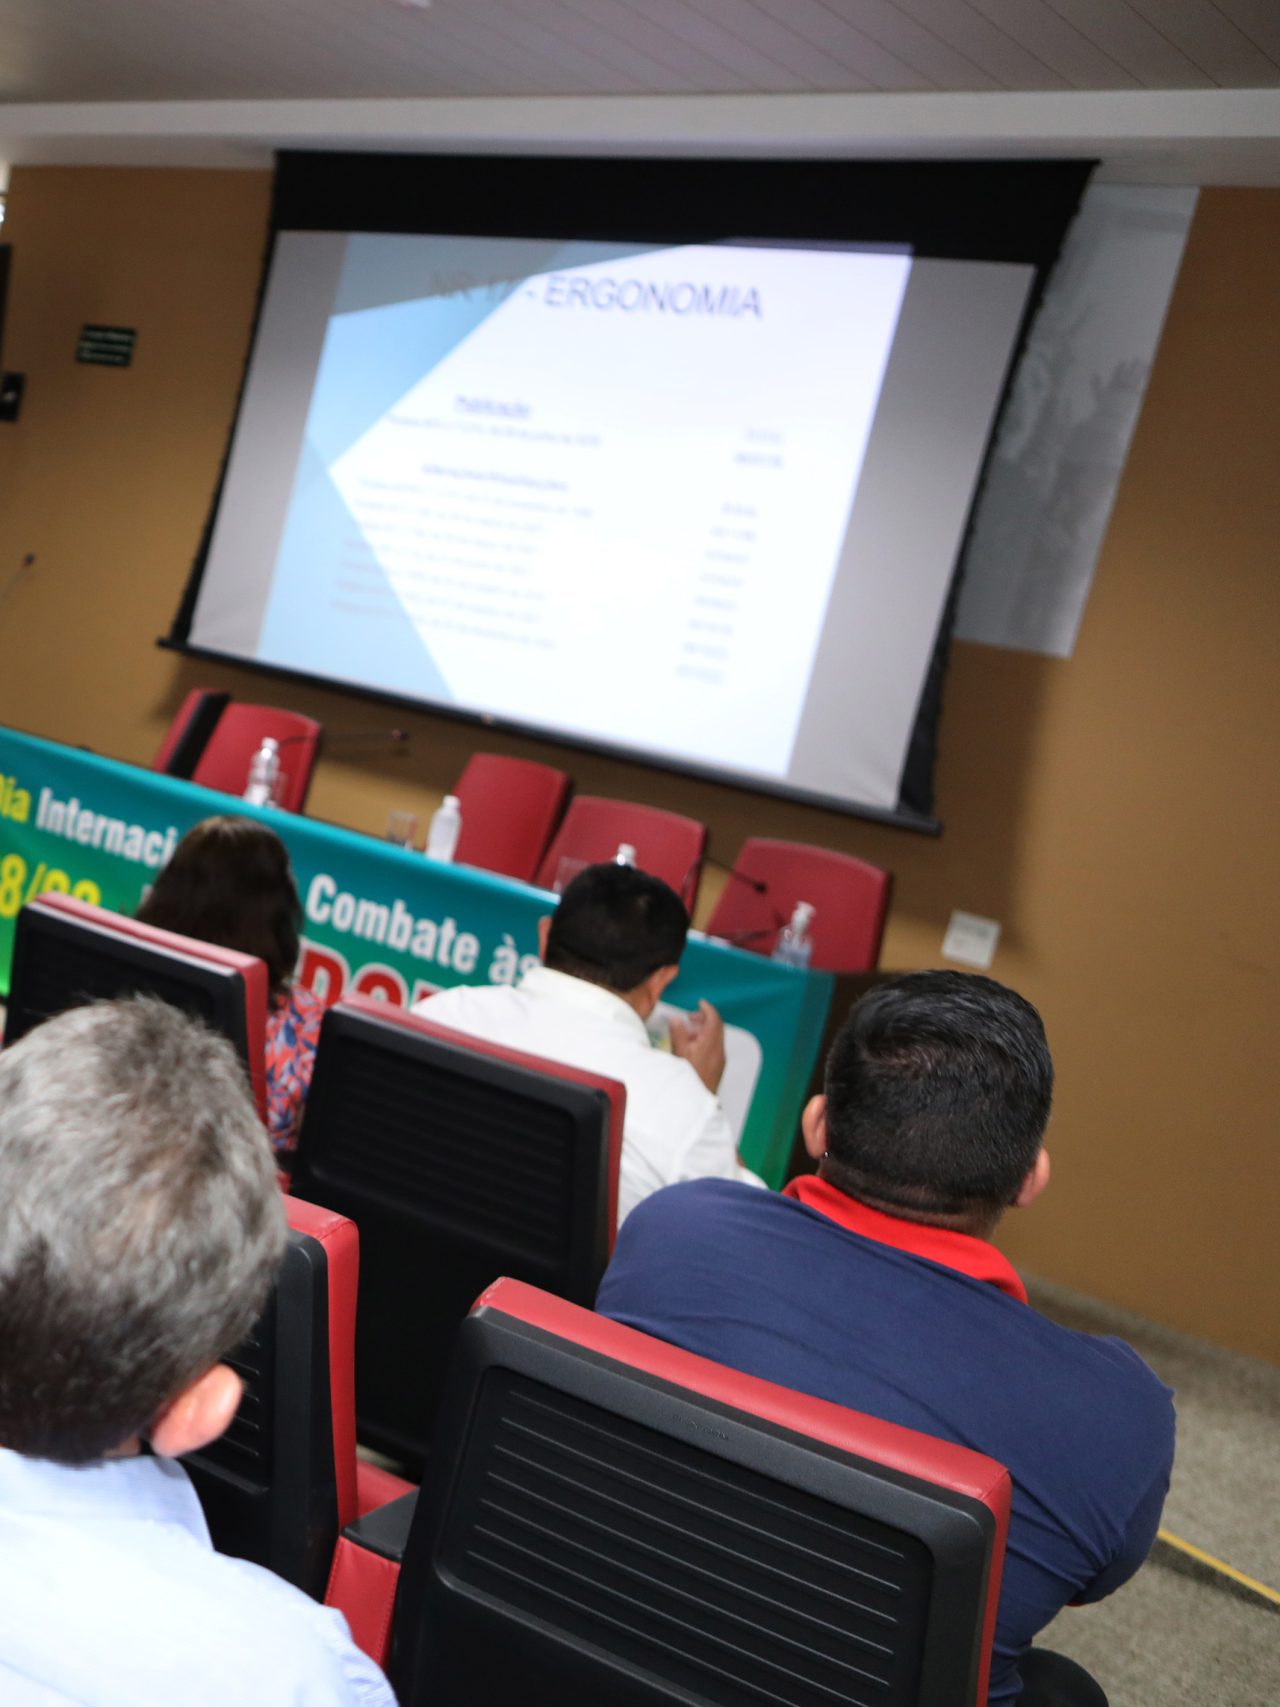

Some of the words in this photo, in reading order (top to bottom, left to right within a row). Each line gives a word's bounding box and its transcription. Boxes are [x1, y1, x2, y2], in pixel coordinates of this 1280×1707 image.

[544, 274, 762, 320] ERGONOMIA
[35, 786, 178, 868] Internaci
[305, 873, 479, 975] Combate
